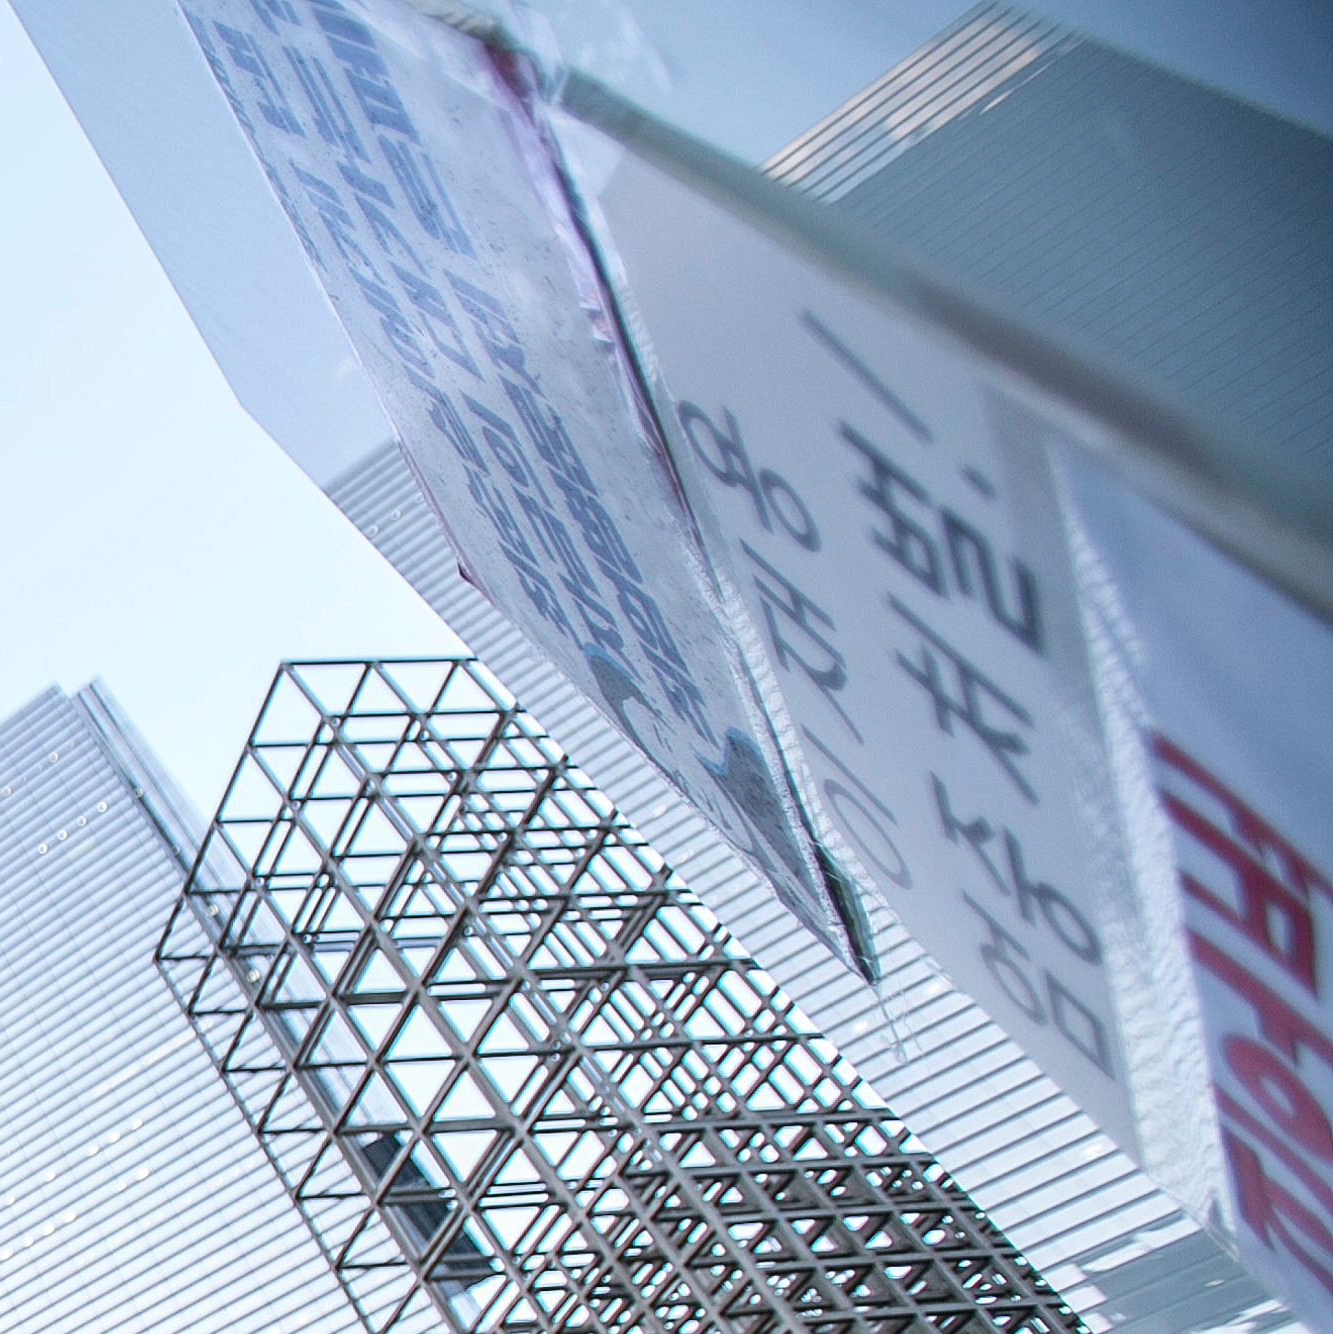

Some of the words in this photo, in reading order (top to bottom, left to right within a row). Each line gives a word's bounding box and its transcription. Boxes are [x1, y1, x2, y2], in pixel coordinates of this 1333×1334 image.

[281, 45, 485, 382] 대가는
[305, 0, 478, 258] 은폐
[289, 162, 581, 647] 최순실에게
[459, 391, 643, 682] 자금의
[678, 400, 913, 890] 이재용
